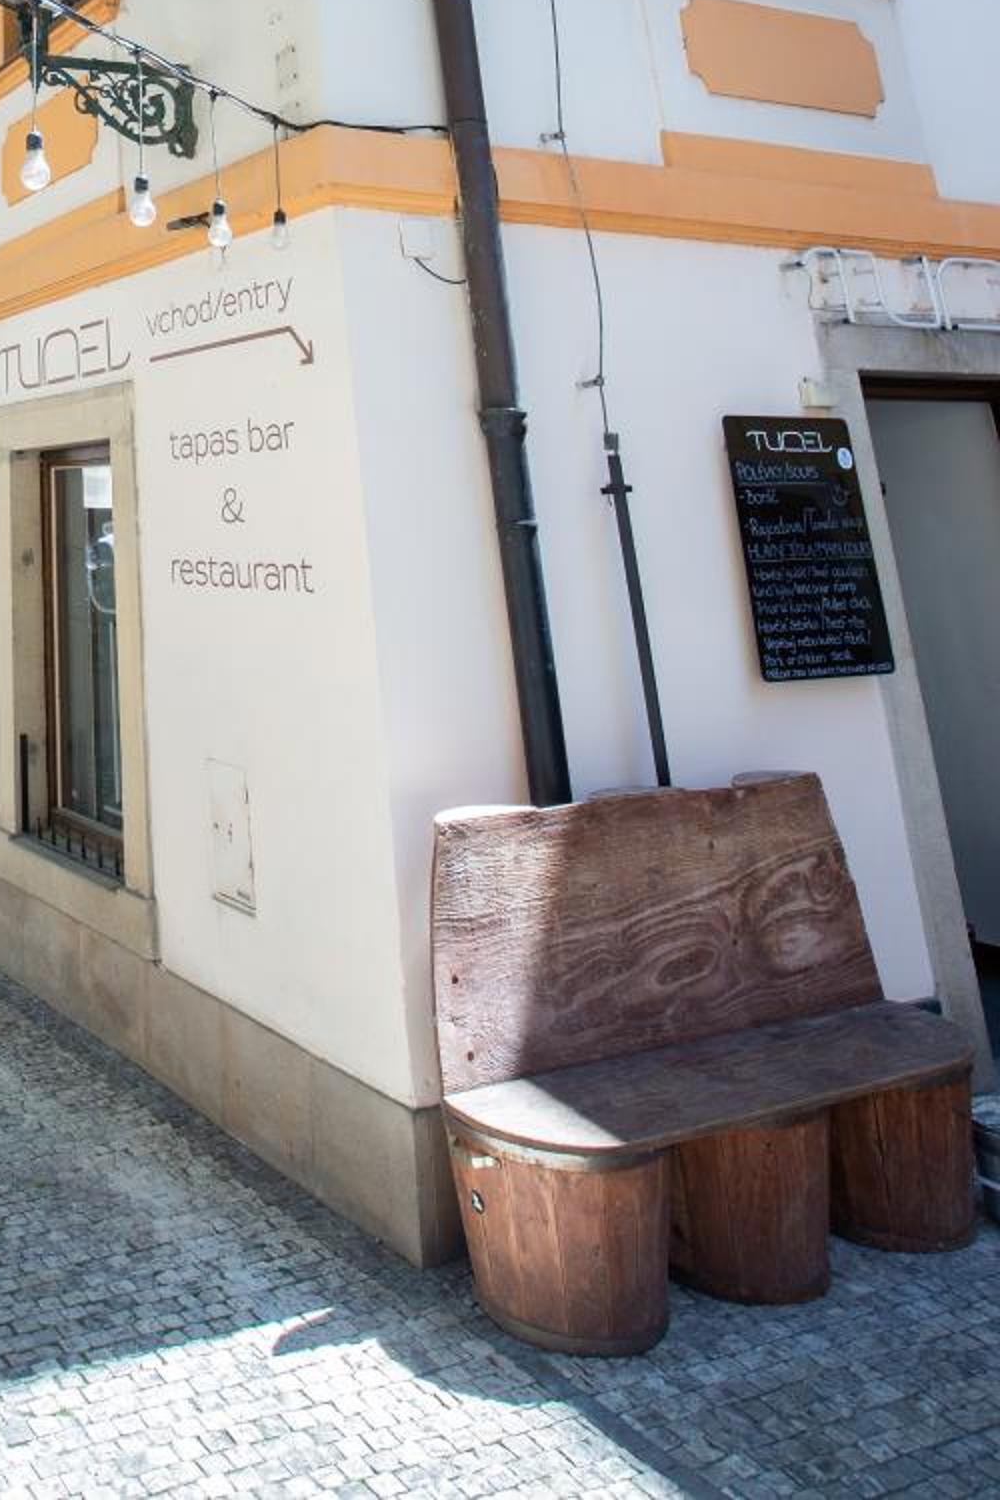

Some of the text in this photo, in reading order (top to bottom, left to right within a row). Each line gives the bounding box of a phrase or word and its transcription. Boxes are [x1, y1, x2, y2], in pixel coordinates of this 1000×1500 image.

[145, 276, 294, 337] vchod/entry
[169, 418, 295, 464] tapas bar
[220, 487, 246, 525] &
[170, 556, 315, 593] restaurant
